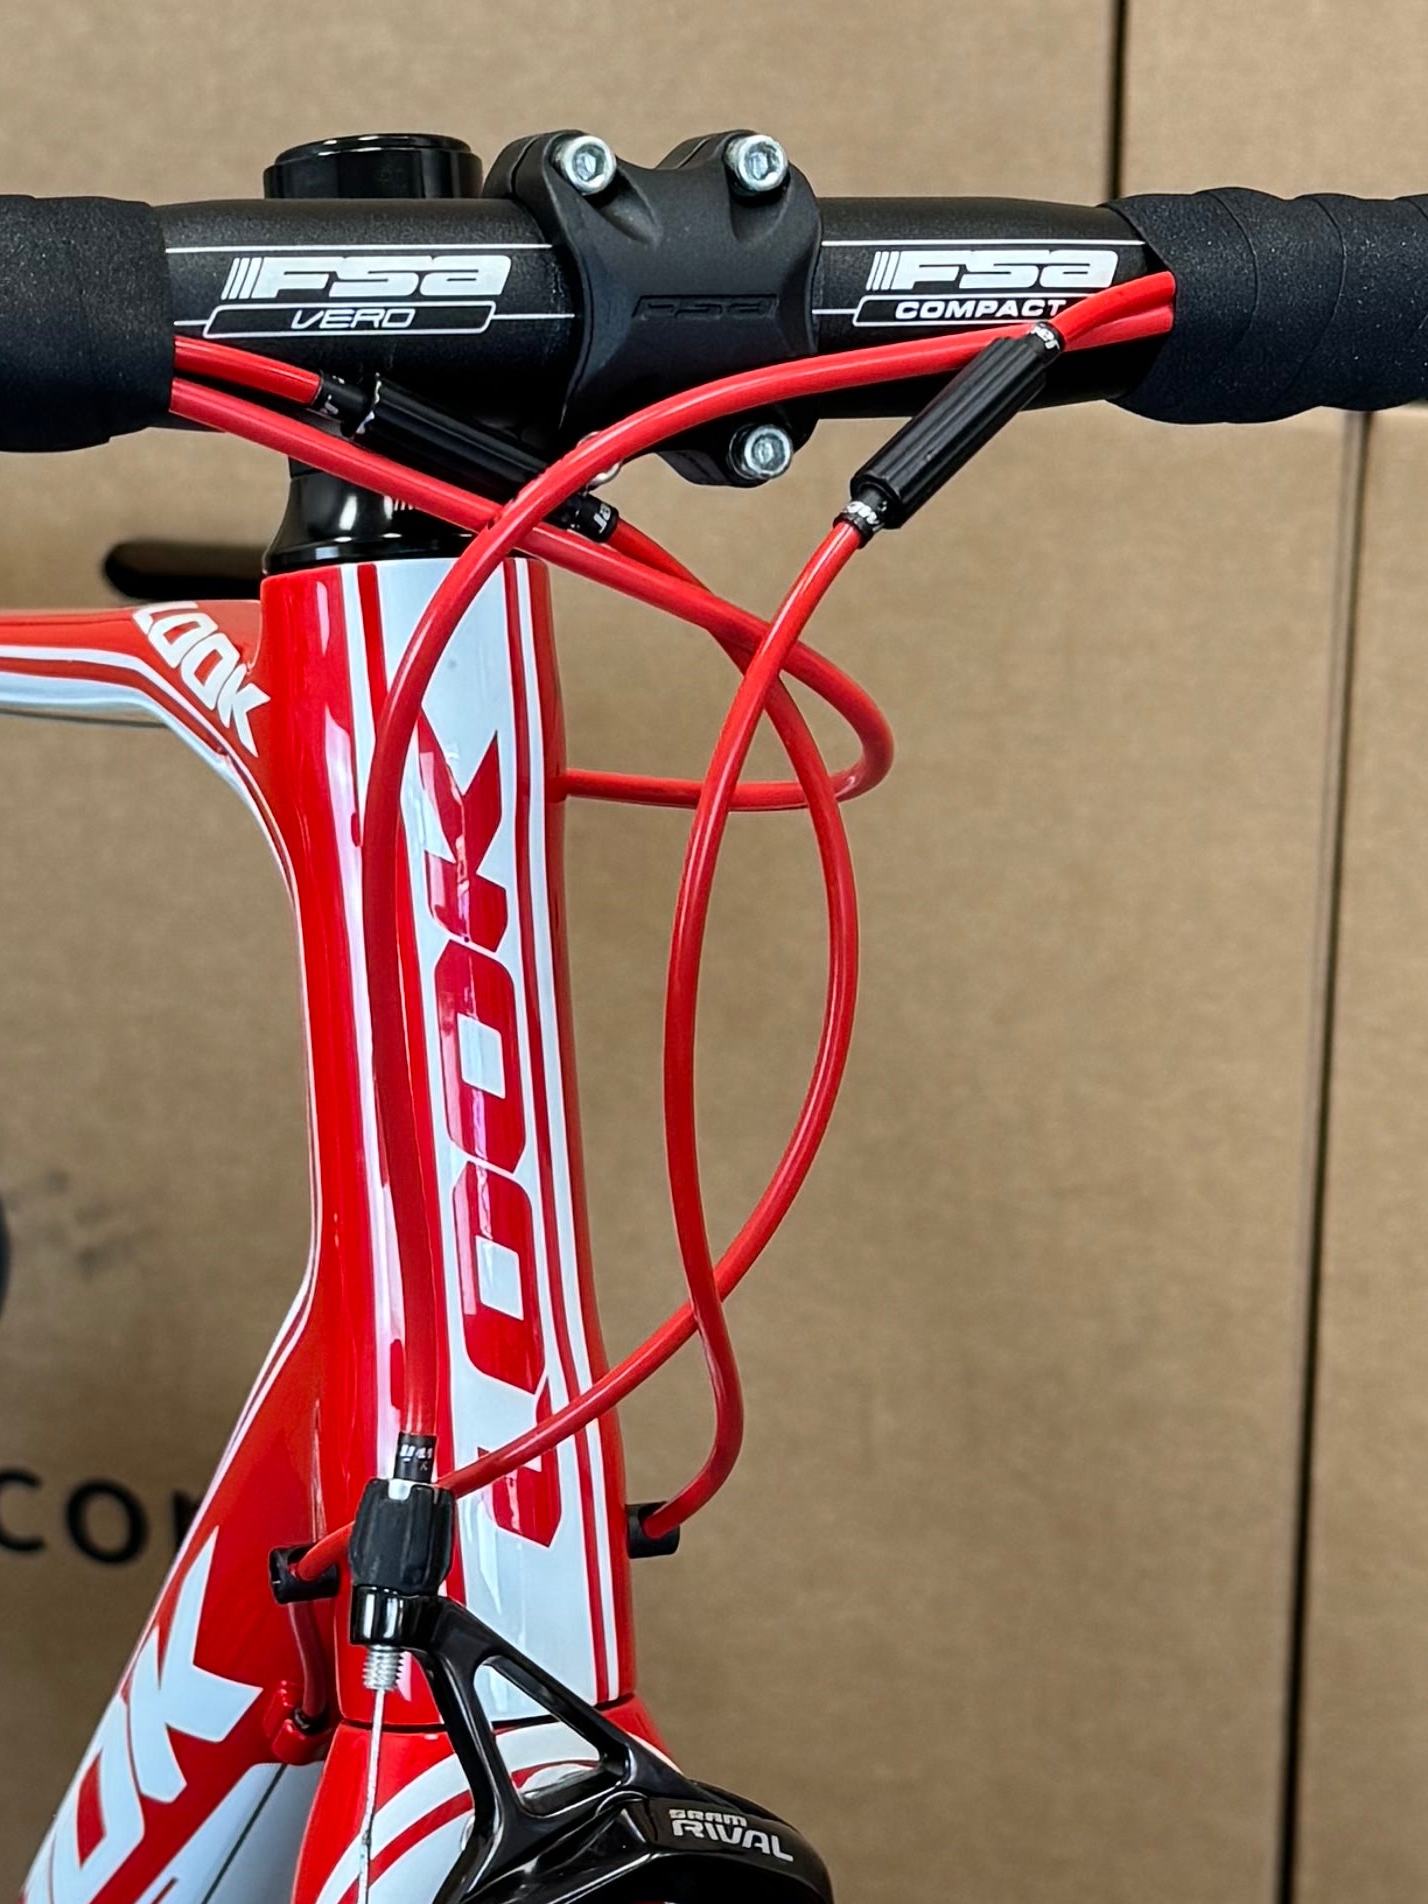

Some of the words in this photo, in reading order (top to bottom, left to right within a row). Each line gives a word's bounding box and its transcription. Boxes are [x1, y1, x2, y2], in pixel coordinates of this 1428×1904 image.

[290, 307, 416, 330] VERO
[894, 298, 1067, 320] COMPACT
[132, 599, 272, 758] LOOK
[668, 1808, 748, 1827] SRAM
[671, 1818, 794, 1862] RIVAL
